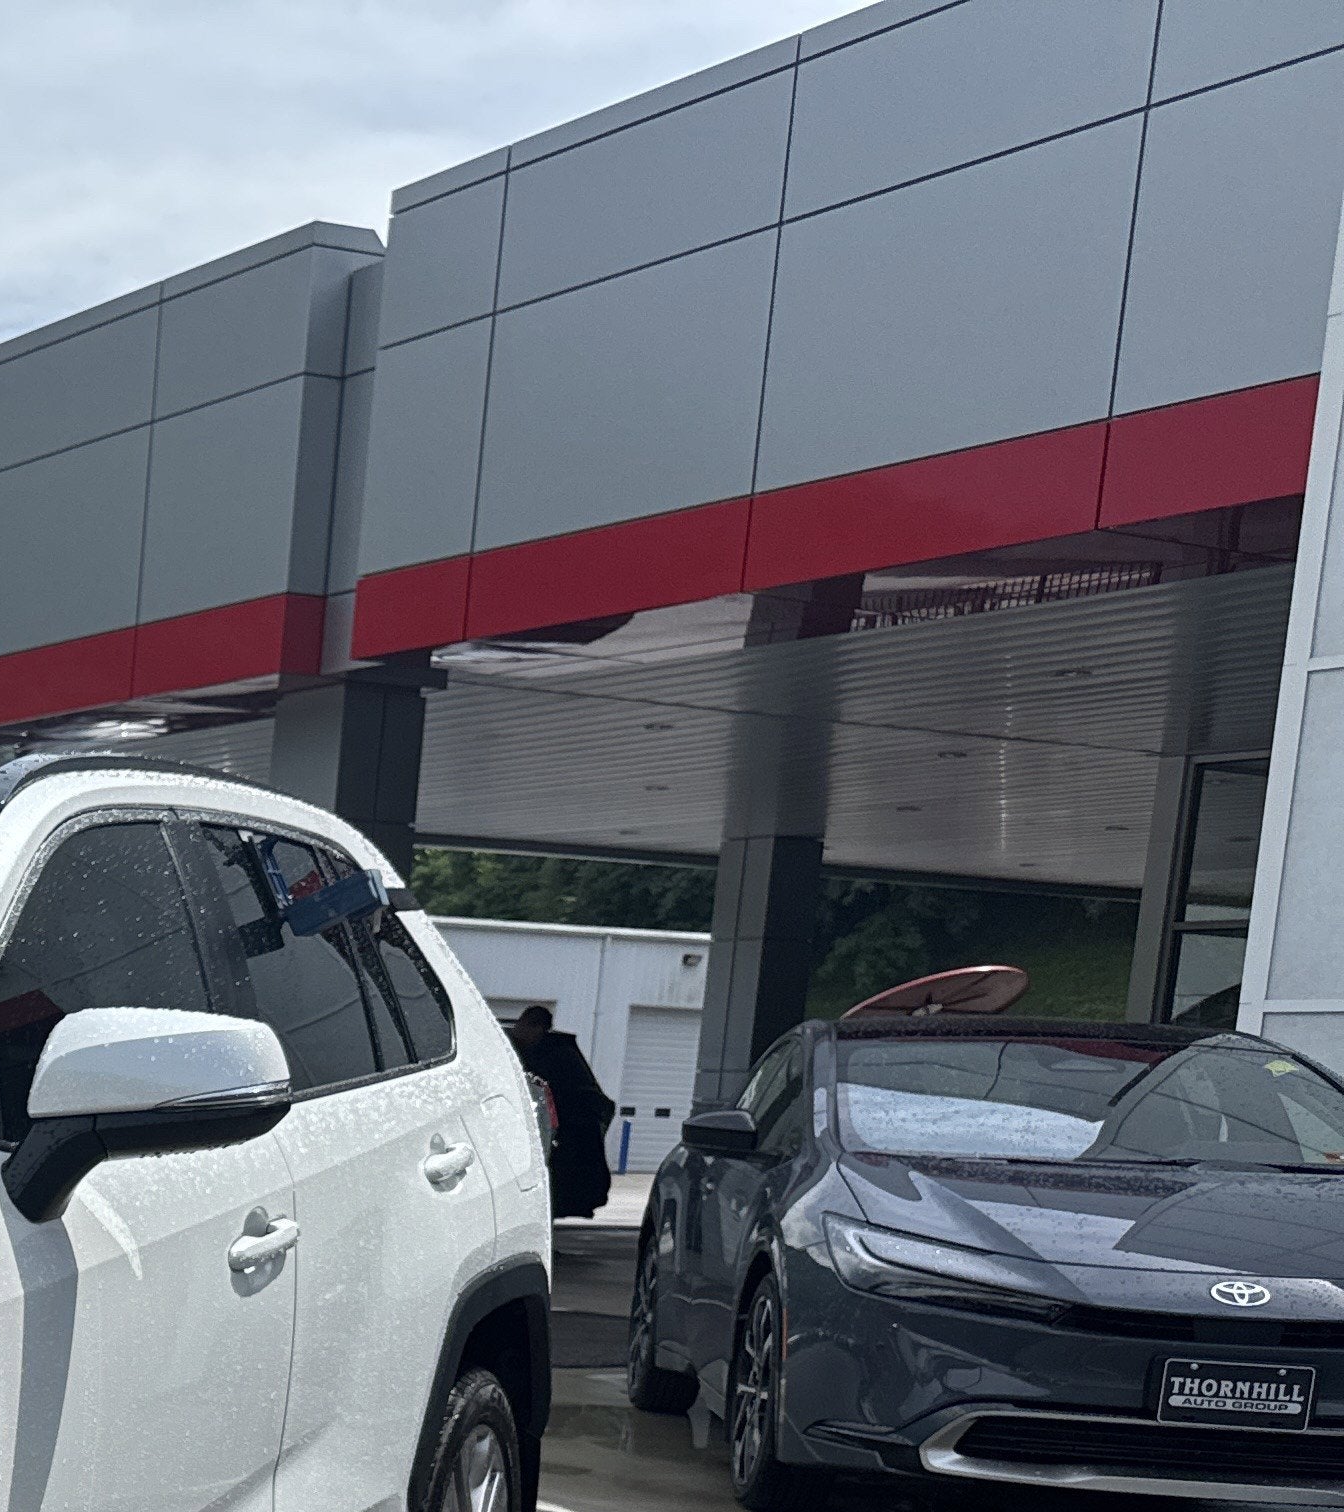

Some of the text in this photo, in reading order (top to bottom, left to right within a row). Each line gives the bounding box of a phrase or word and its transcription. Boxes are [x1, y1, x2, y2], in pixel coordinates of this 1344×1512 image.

[1169, 1376, 1305, 1402] THORNHILL
[1181, 1397, 1289, 1412] AUTO GROUP
